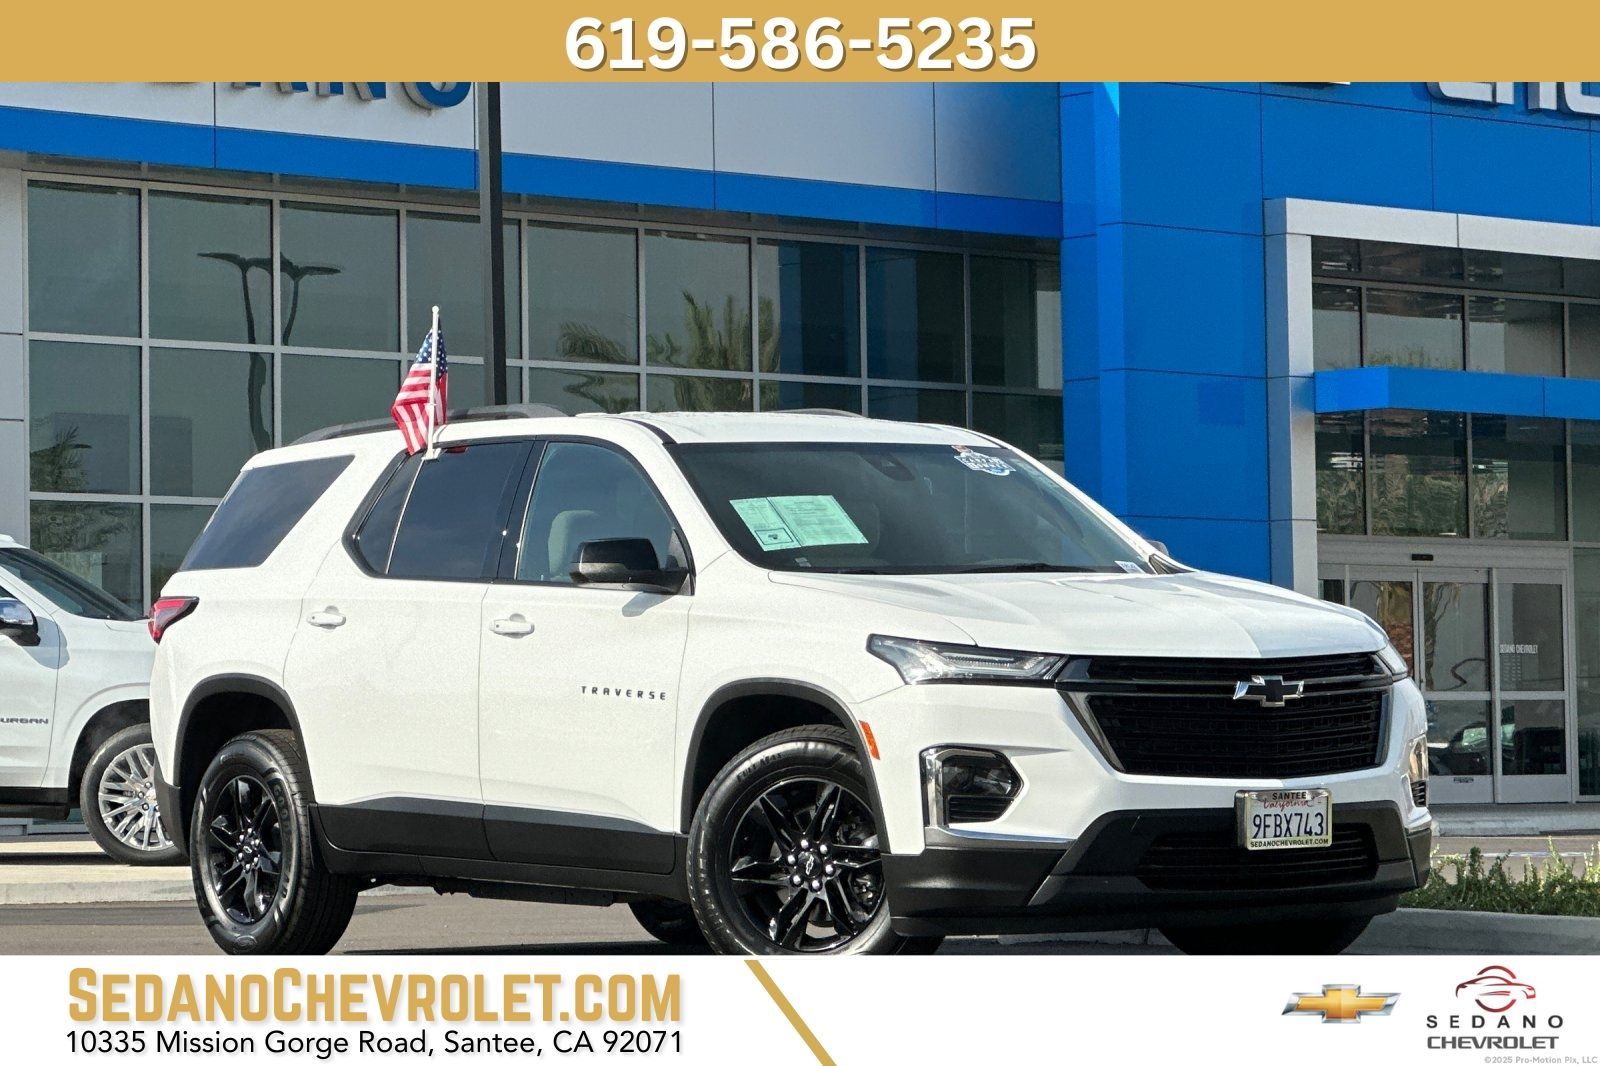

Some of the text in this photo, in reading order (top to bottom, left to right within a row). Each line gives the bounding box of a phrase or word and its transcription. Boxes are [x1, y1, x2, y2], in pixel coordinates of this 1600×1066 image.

[581, 685, 666, 701] TRAVERSE
[1272, 791, 1307, 800] SANTEE
[1252, 812, 1325, 839] 9FBX743
[1250, 838, 1329, 848] SEDANOCHEVROLET.COM
